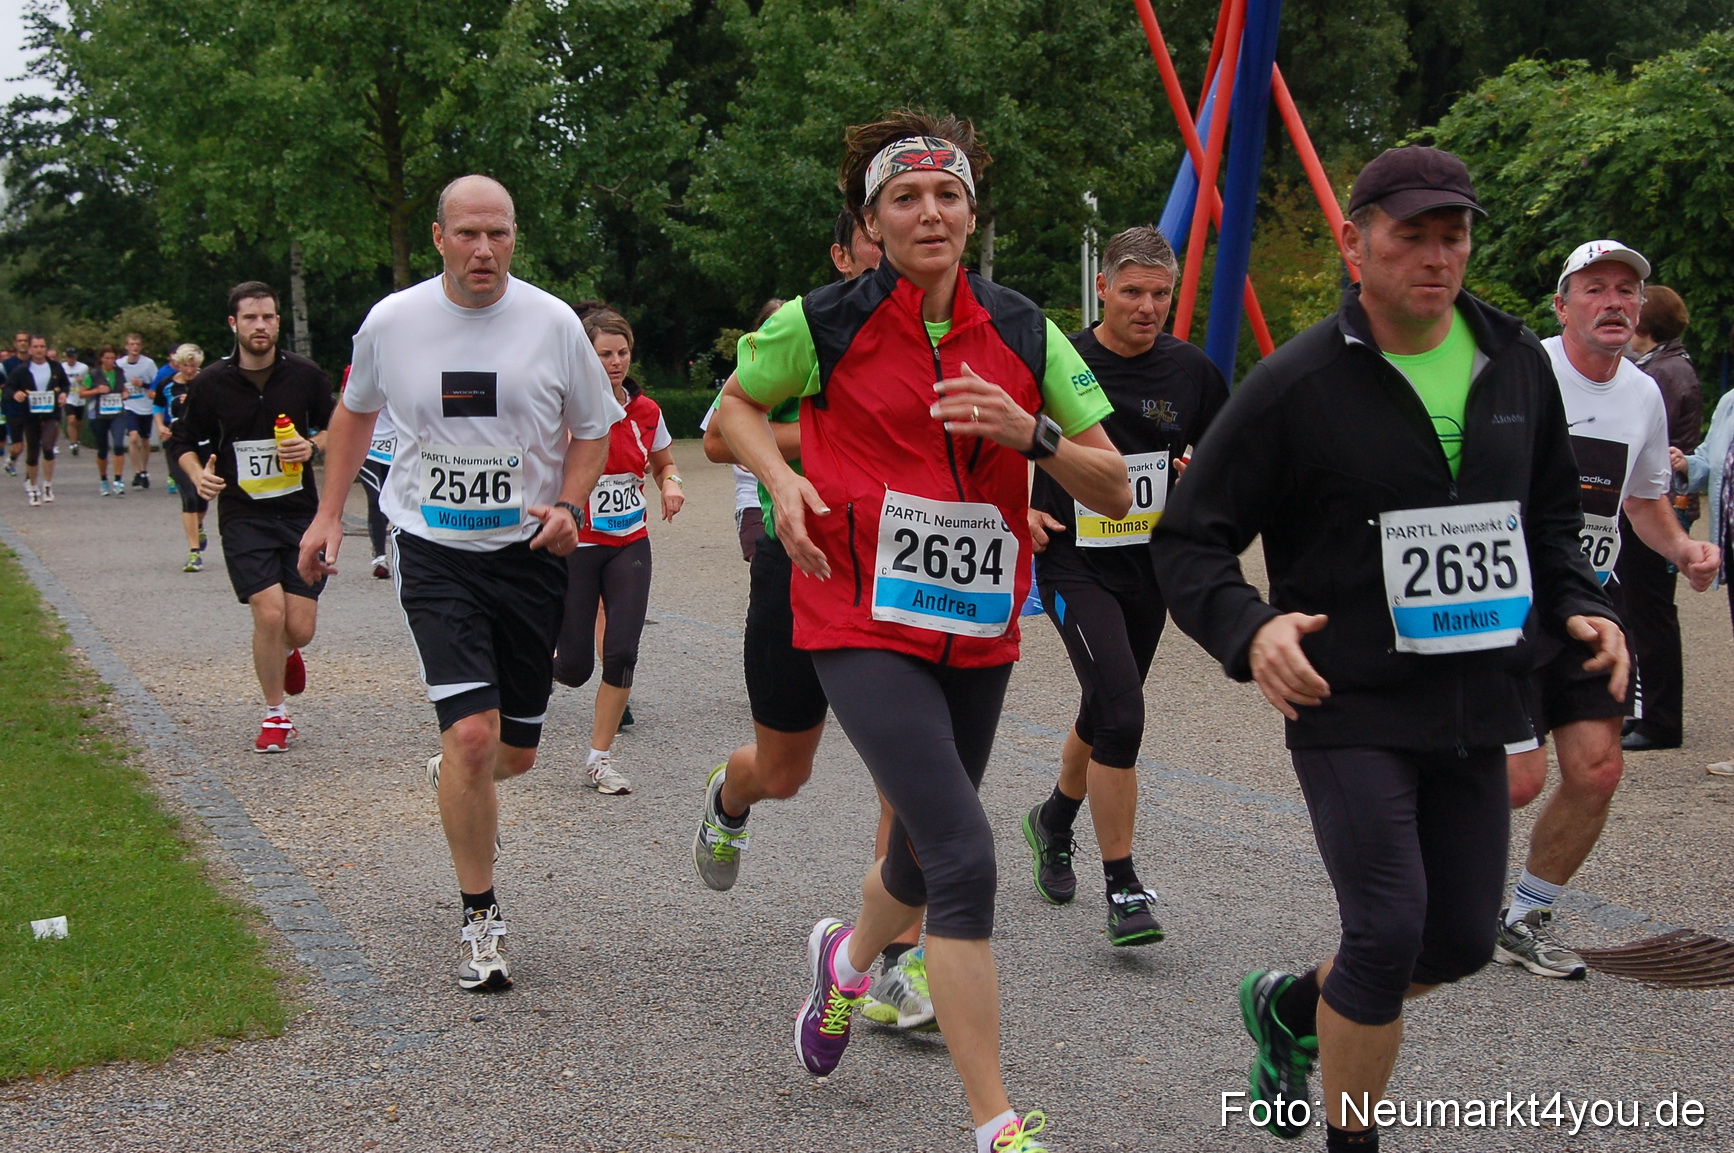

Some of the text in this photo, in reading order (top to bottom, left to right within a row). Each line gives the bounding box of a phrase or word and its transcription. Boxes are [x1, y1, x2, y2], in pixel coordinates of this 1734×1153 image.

[421, 451, 503, 466] PARTL Neumarkt
[1125, 463, 1153, 473] markt
[430, 467, 511, 504] 2546
[597, 484, 641, 514] 2928
[438, 511, 500, 530] Wolfgang
[885, 504, 996, 530] PARTL Neumarkt
[1100, 520, 1149, 534] Thomas
[1386, 518, 1503, 540] PARTL Neumarkt
[1583, 522, 1612, 533] markt
[892, 528, 1003, 586] 2634
[1402, 540, 1518, 598] 2635
[912, 589, 977, 617] Andrea
[1432, 608, 1500, 632] Markus
